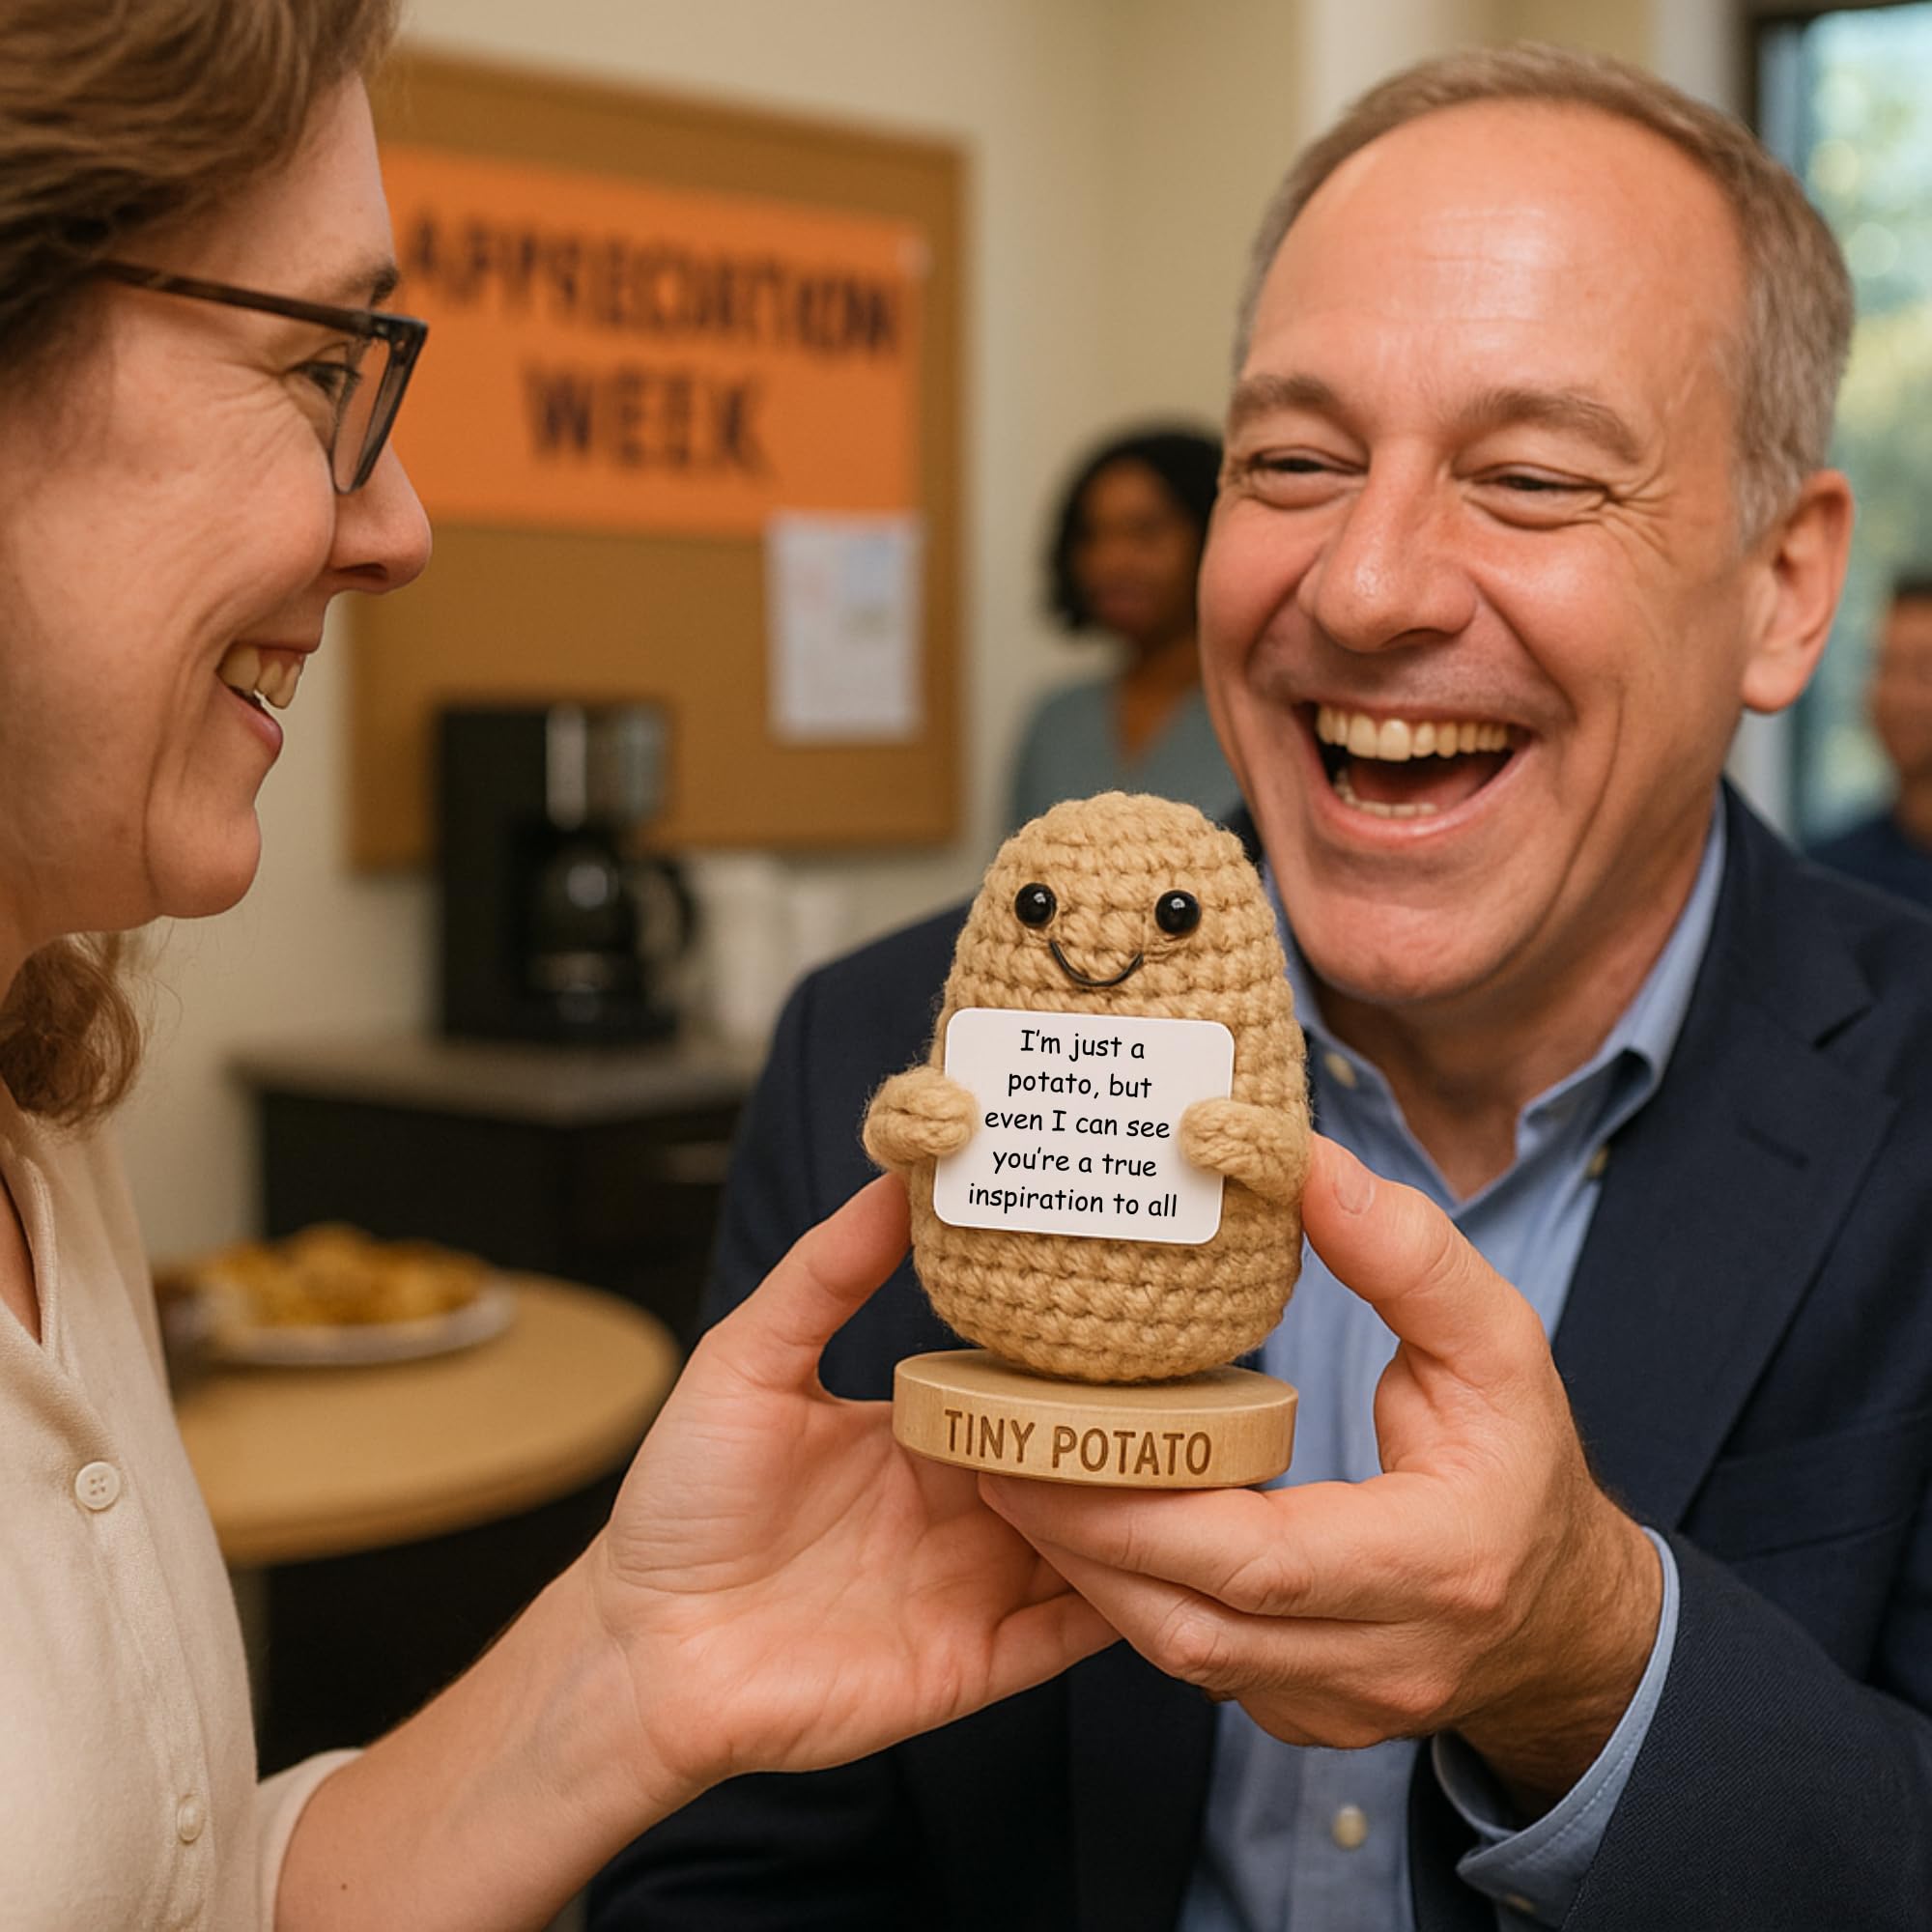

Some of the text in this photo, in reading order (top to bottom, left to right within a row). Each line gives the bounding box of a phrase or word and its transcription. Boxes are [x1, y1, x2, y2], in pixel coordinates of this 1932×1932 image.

[520, 359, 771, 474] WEEK
[1020, 1029, 1145, 1063] I'm just a
[1008, 1070, 1152, 1099] potato, but
[984, 1109, 1171, 1139] even I can see
[992, 1146, 1157, 1178] you're a true
[968, 1182, 1177, 1218] inspiration to all
[944, 1408, 1212, 1476] TINY POTATO
